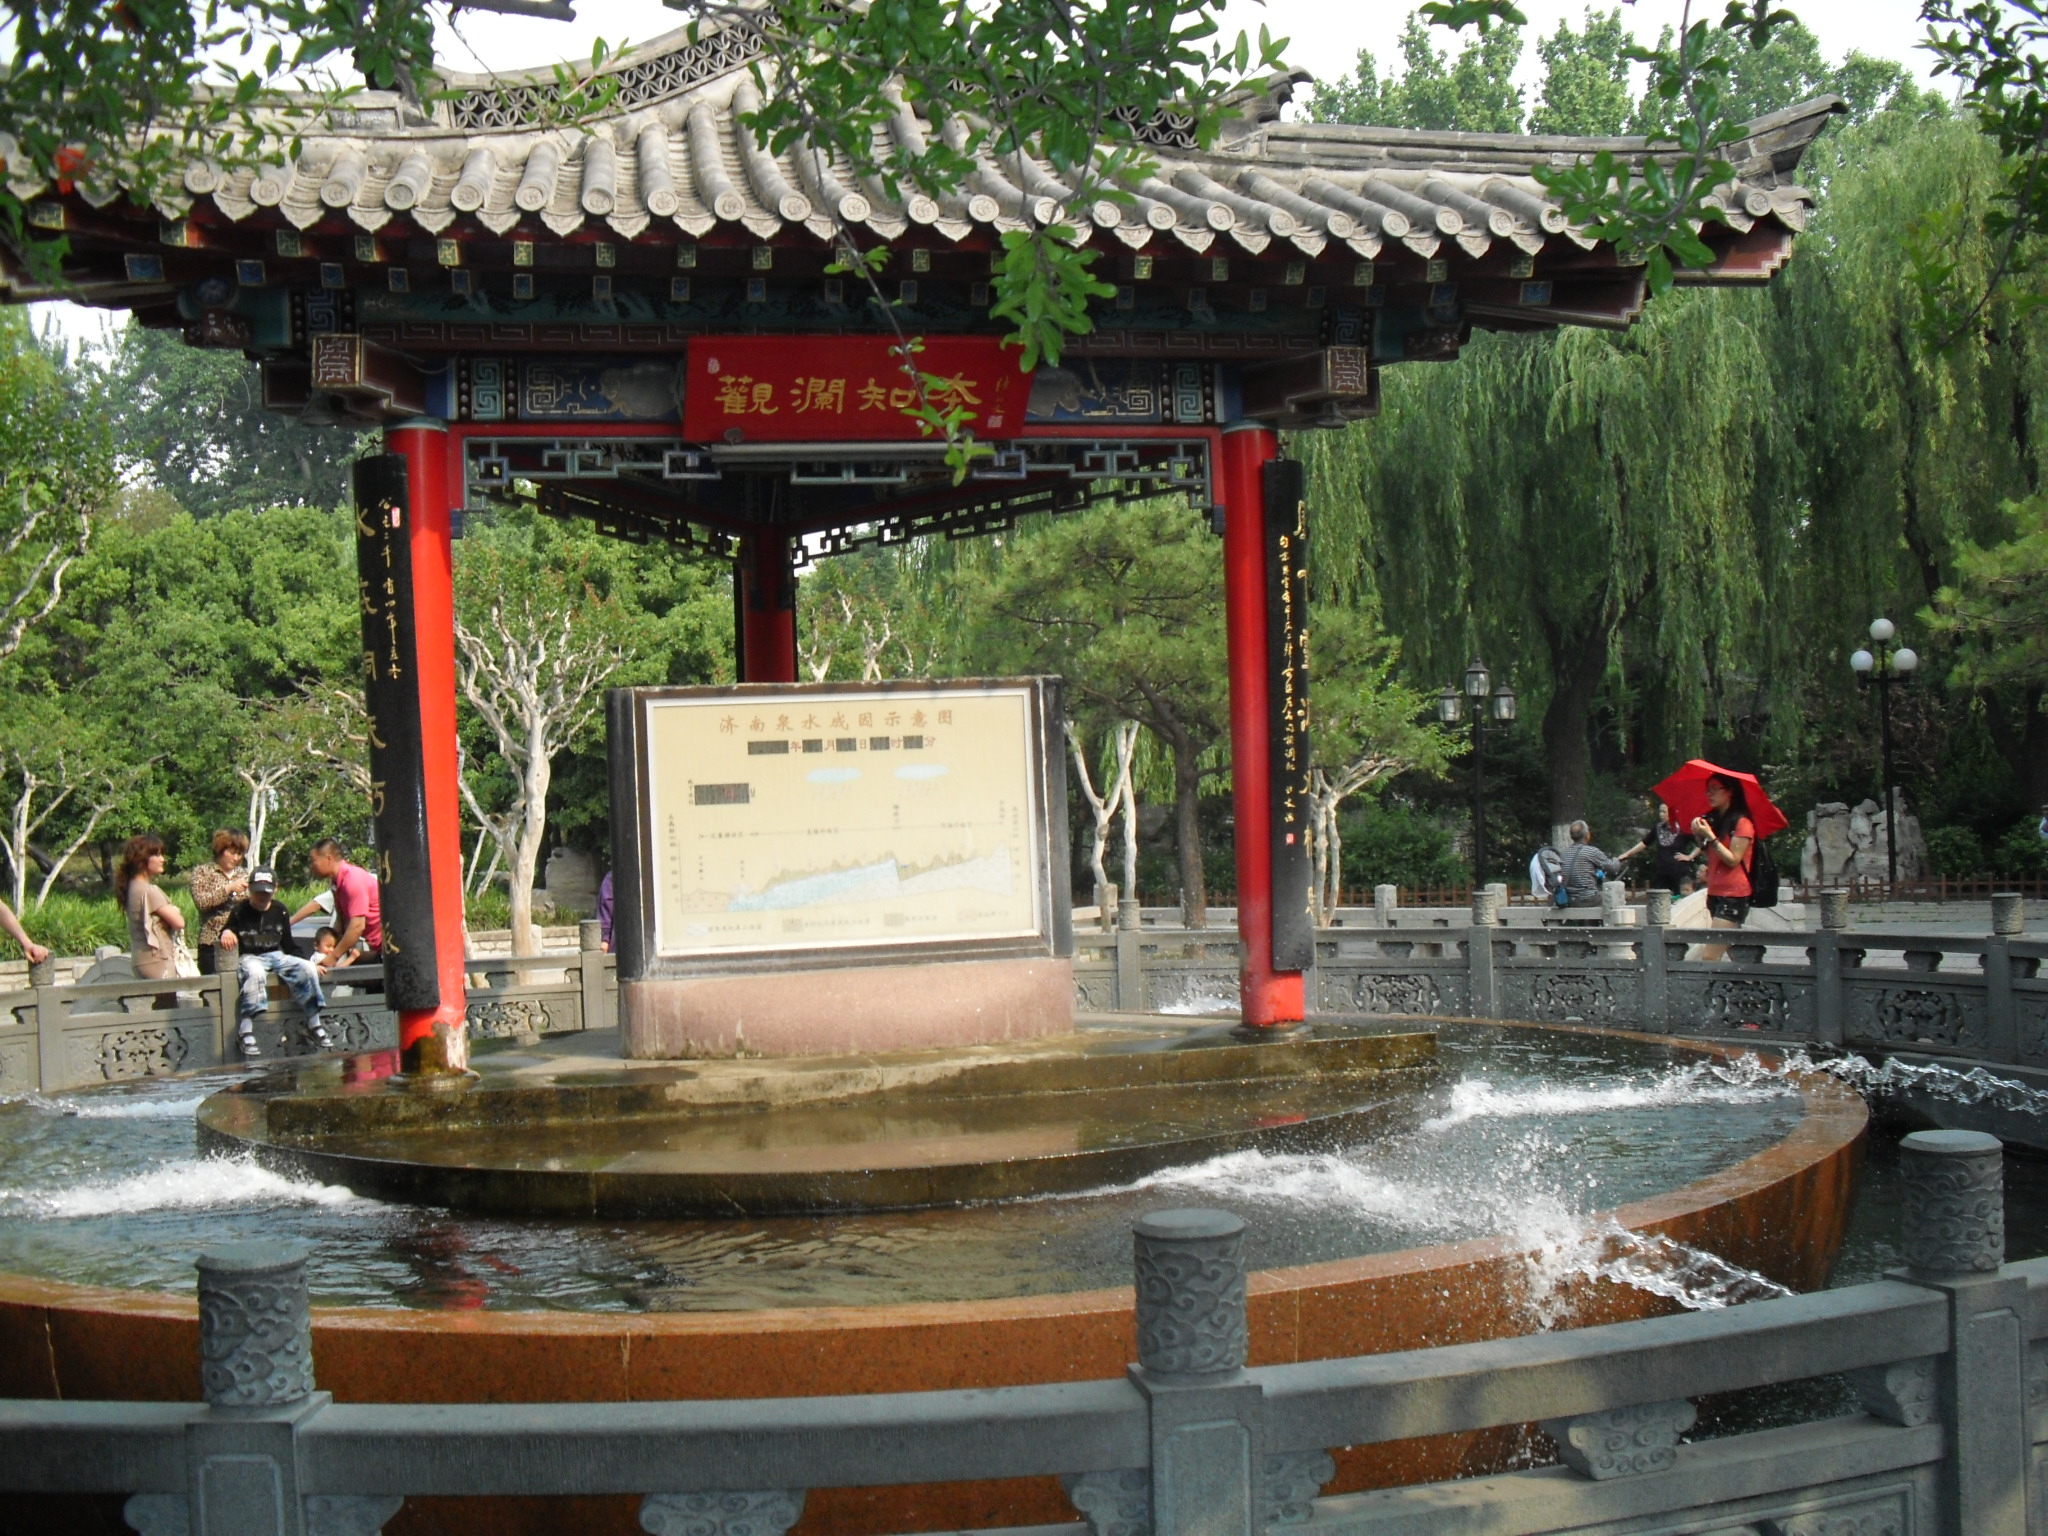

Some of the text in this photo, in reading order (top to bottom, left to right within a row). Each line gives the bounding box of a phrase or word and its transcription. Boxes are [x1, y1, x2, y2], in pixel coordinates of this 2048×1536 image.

[719, 709, 953, 736] 济南泉水成因示意图
